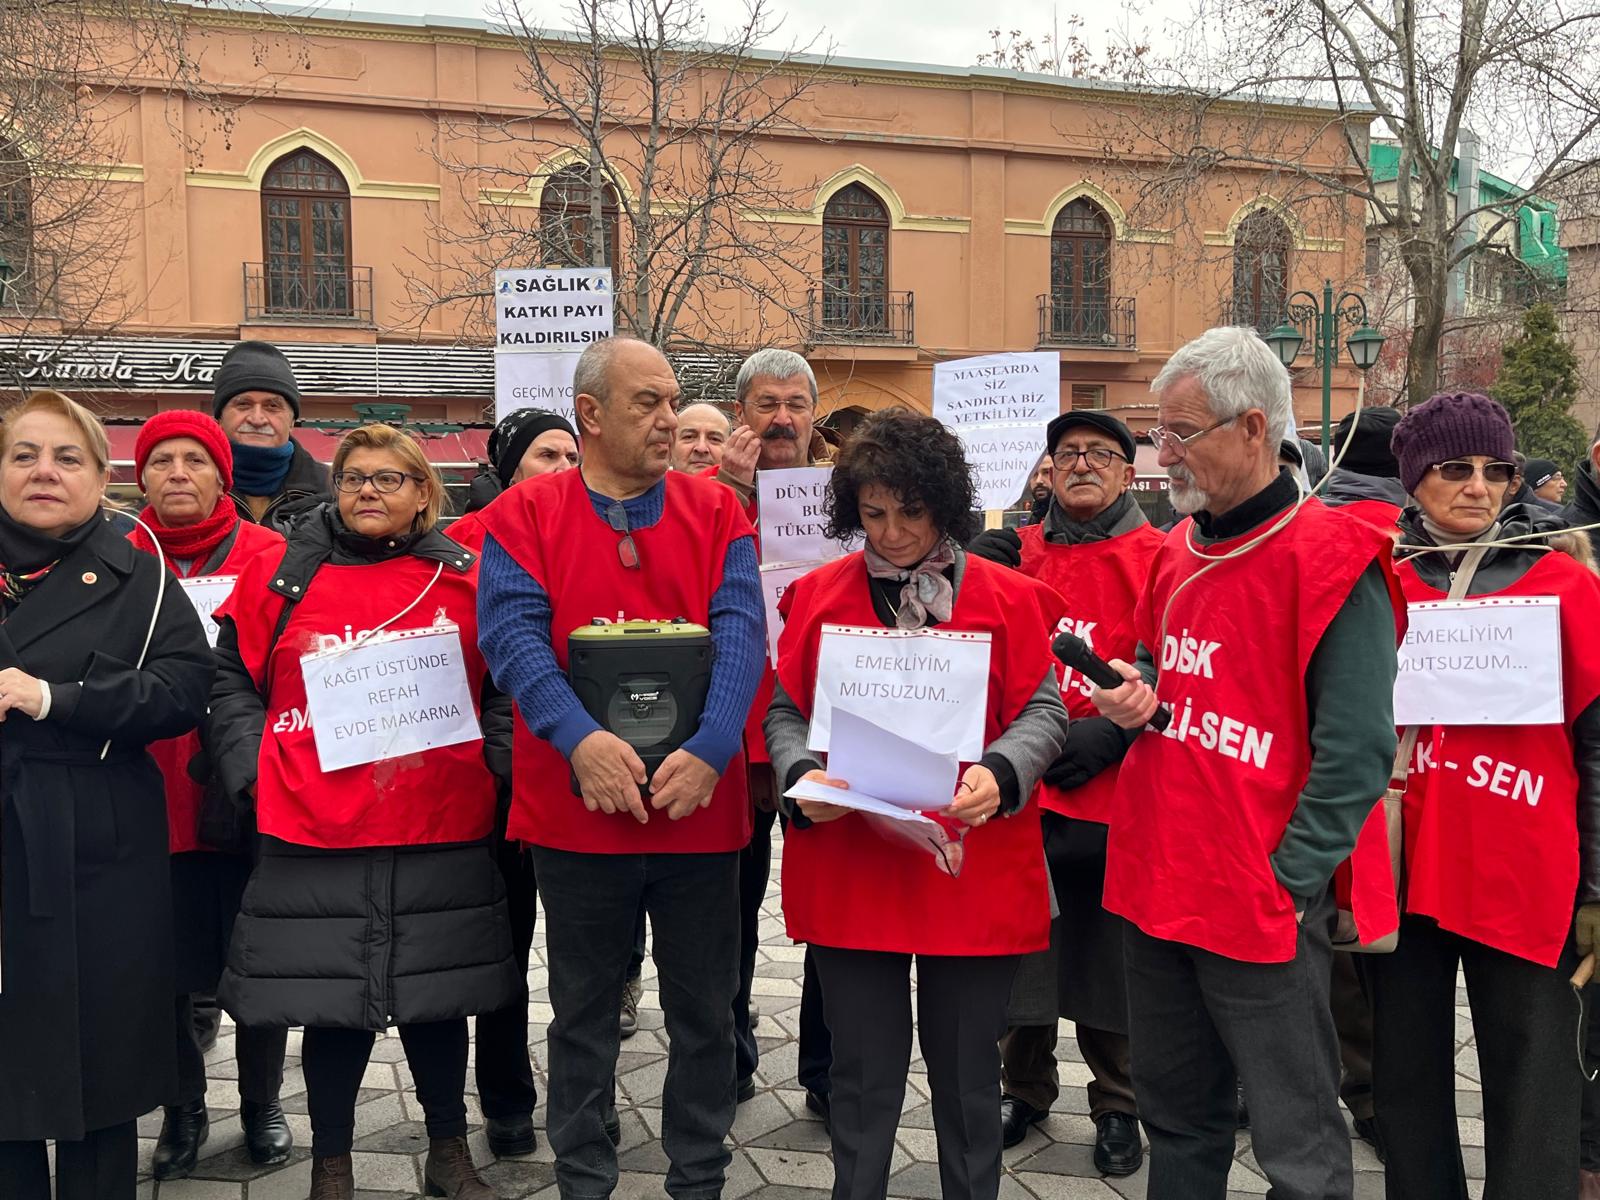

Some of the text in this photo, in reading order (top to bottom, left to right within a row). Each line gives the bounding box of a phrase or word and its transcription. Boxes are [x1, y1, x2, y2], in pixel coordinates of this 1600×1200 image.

[515, 275, 591, 293] SAĞLIK
[504, 304, 604, 319] KATKI PAYI
[500, 330, 610, 345] KALDIRILSIN
[953, 364, 1040, 381] MAAŞLARDA
[512, 385, 554, 400] GEÇİM
[984, 379, 1008, 391] SİZ
[946, 391, 1047, 412] SANDIKTA BİZ
[954, 406, 1038, 424] YETKİLİYİZ
[775, 484, 808, 500] DÜN
[1405, 623, 1514, 646] EMEKLİYİM
[854, 652, 951, 674] EMEKLİYİM
[1161, 628, 1222, 680] DİSK
[323, 652, 450, 689] KAĞIT ÜSTÜNDE
[367, 683, 421, 706] REFAH
[840, 682, 961, 705] MUTSUZUM...
[334, 703, 462, 741] EVDE MAKARNA
[1466, 754, 1545, 807] SEN
